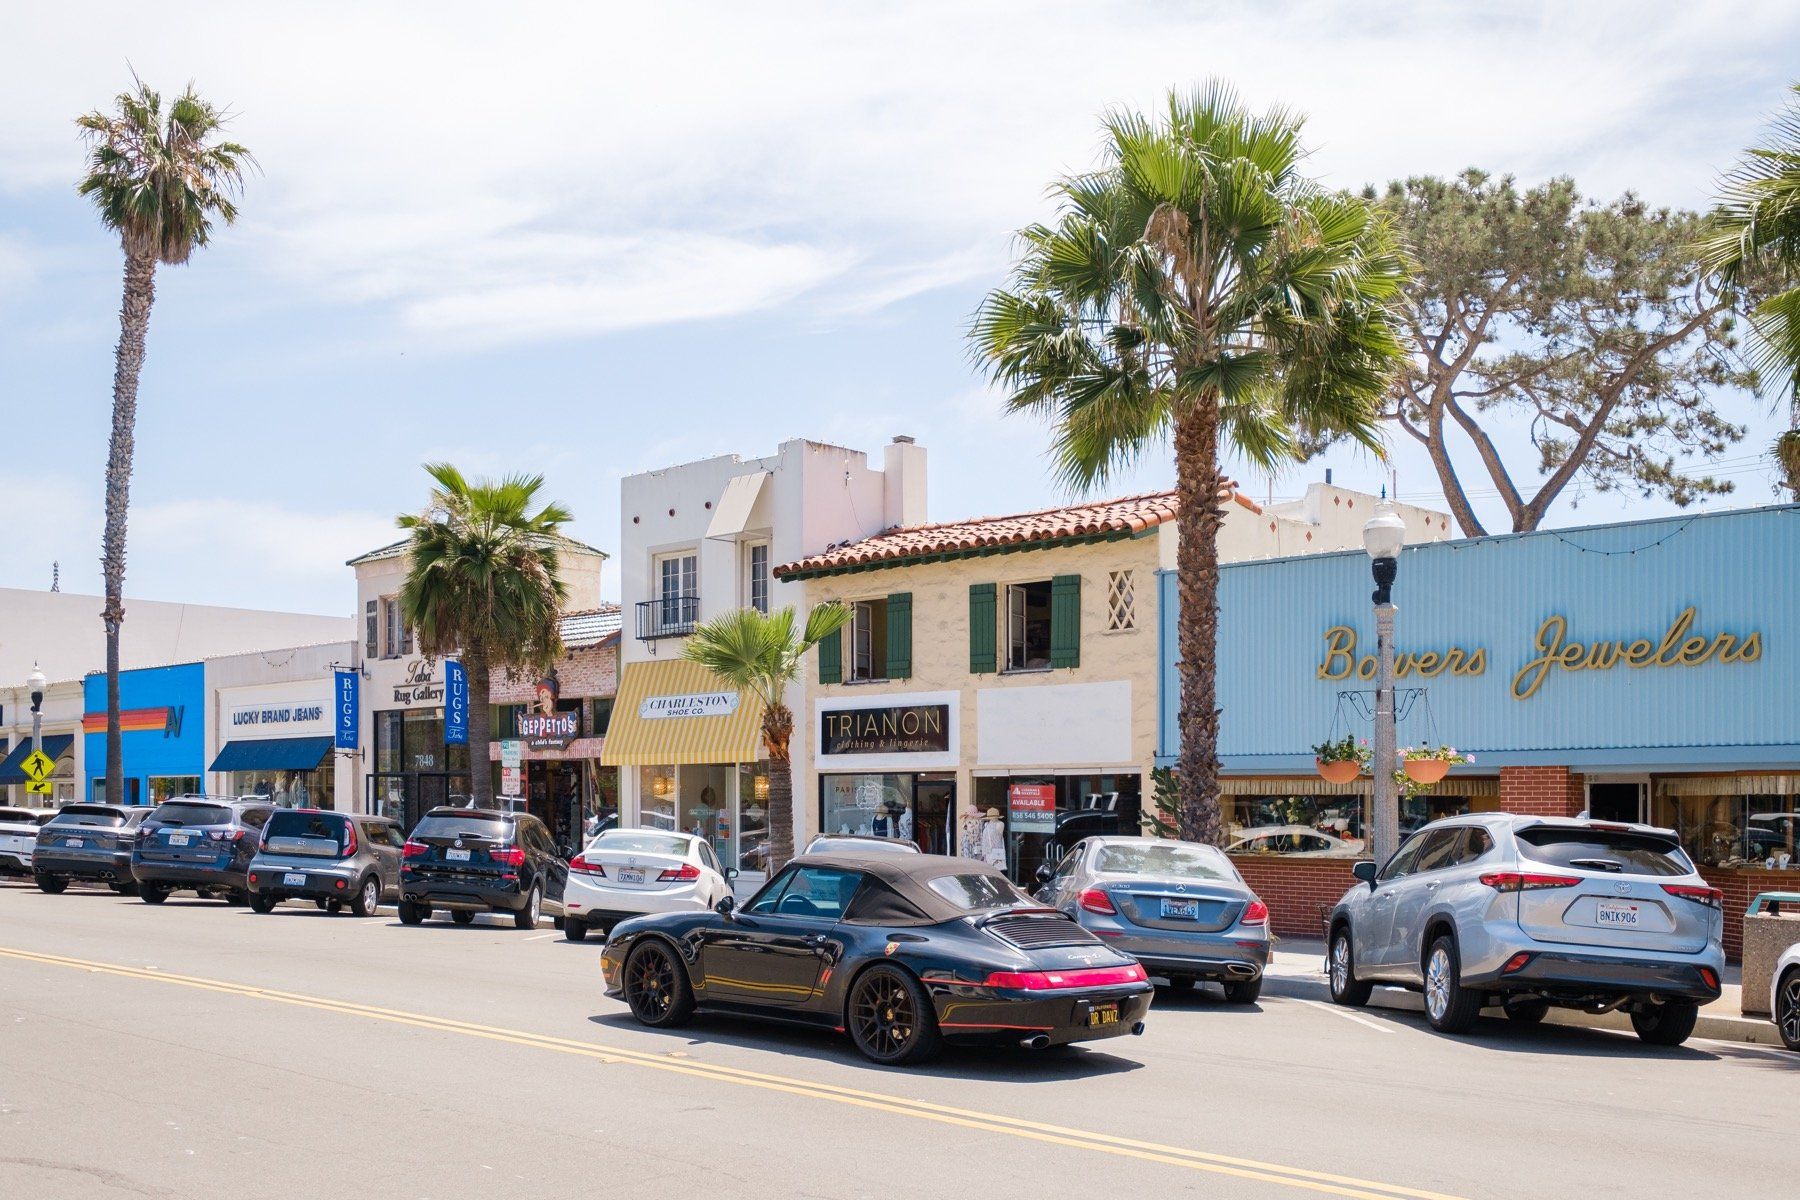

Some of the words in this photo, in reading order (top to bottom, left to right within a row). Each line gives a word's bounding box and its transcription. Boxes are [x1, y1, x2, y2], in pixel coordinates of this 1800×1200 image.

[1510, 605, 1762, 701] Jewelers
[343, 678, 353, 727] RUGS
[394, 689, 411, 705] Rug
[413, 686, 444, 702] Gallery
[452, 669, 462, 724] RUGS
[650, 695, 730, 709] CHARLESTON
[233, 711, 260, 726] LUCKY
[262, 709, 290, 724] BRAND
[292, 707, 321, 722] JEANS
[826, 710, 941, 738] TRIANON
[522, 715, 575, 737] GEPPETTO'S
[836, 740, 875, 750] clothing
[889, 737, 929, 748] lingerie
[415, 754, 434, 767] 7848
[1012, 799, 1046, 807] AVAILABLE
[1037, 812, 1054, 820] 5400
[1600, 910, 1637, 923] 8NIK906
[1090, 1011, 1100, 1025] DR
